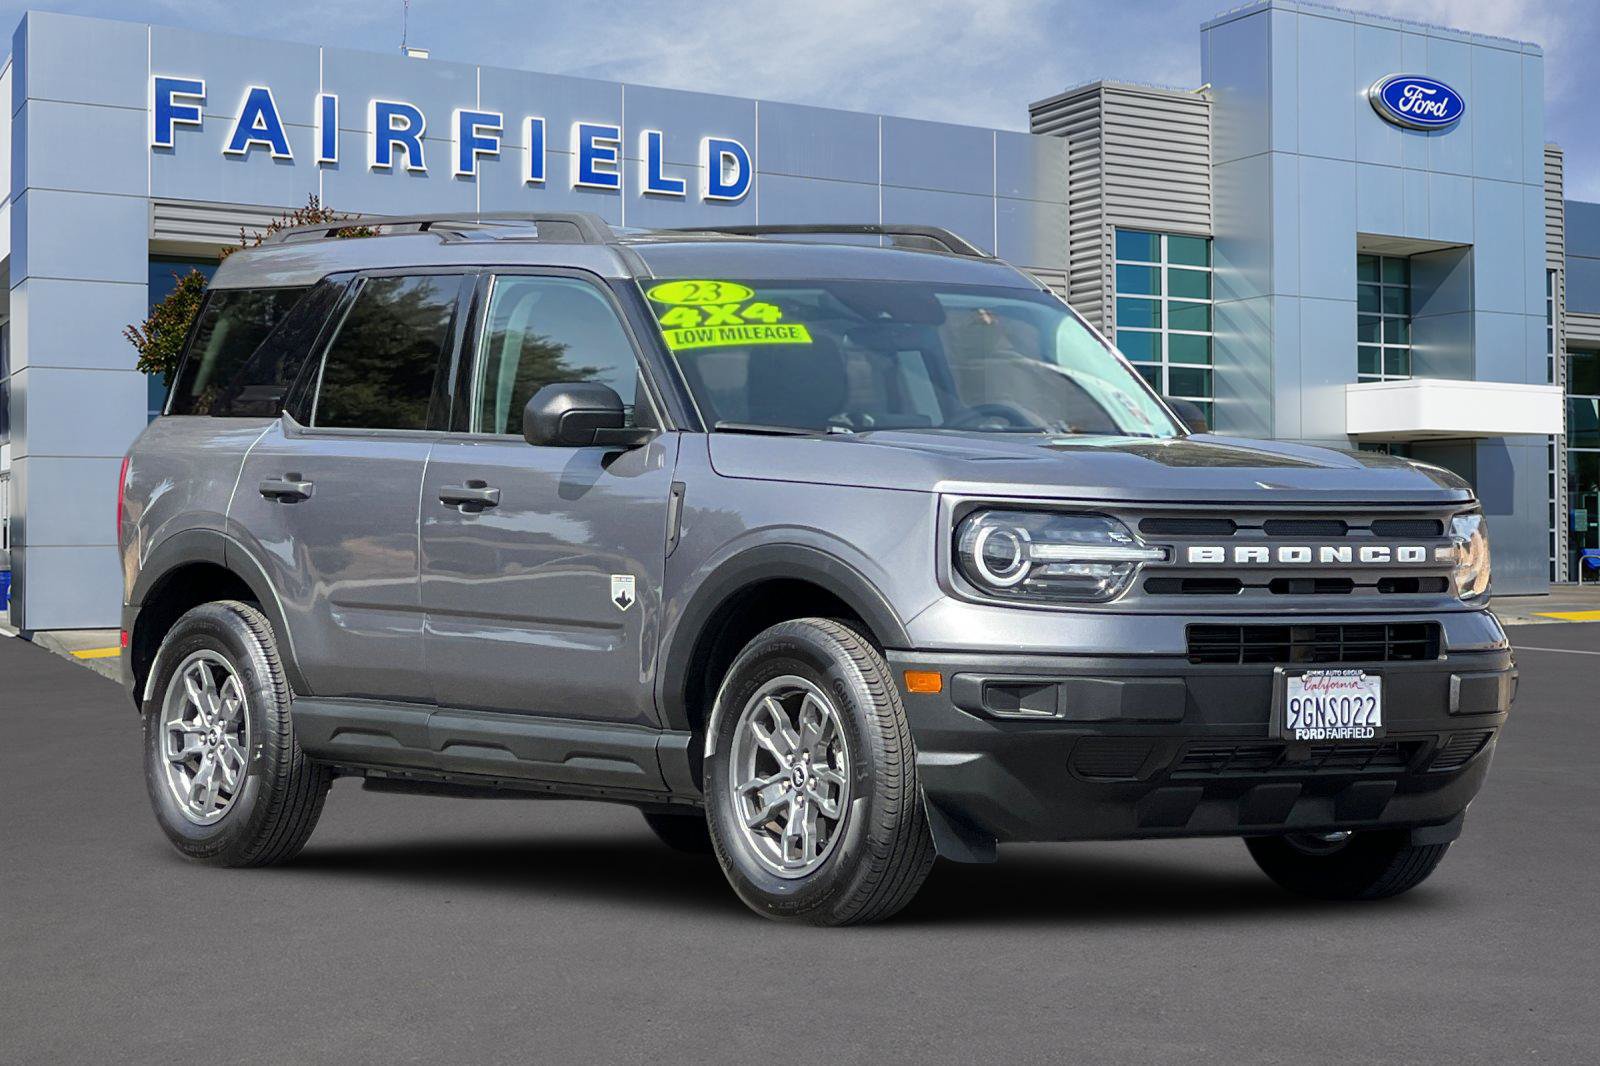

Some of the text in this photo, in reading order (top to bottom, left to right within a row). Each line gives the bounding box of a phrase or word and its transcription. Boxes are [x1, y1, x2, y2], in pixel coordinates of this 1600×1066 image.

[1398, 84, 1449, 117] Ford
[150, 74, 754, 201] FAIRFIELD
[682, 283, 722, 302] 23
[659, 302, 782, 328] 4X4
[674, 326, 799, 345] LOW MILEAGE
[1188, 546, 1426, 563] BRONCO
[1303, 674, 1364, 694] California
[1289, 696, 1376, 729] 9GNS022
[1295, 727, 1375, 740] FORD FAIRFIELD
